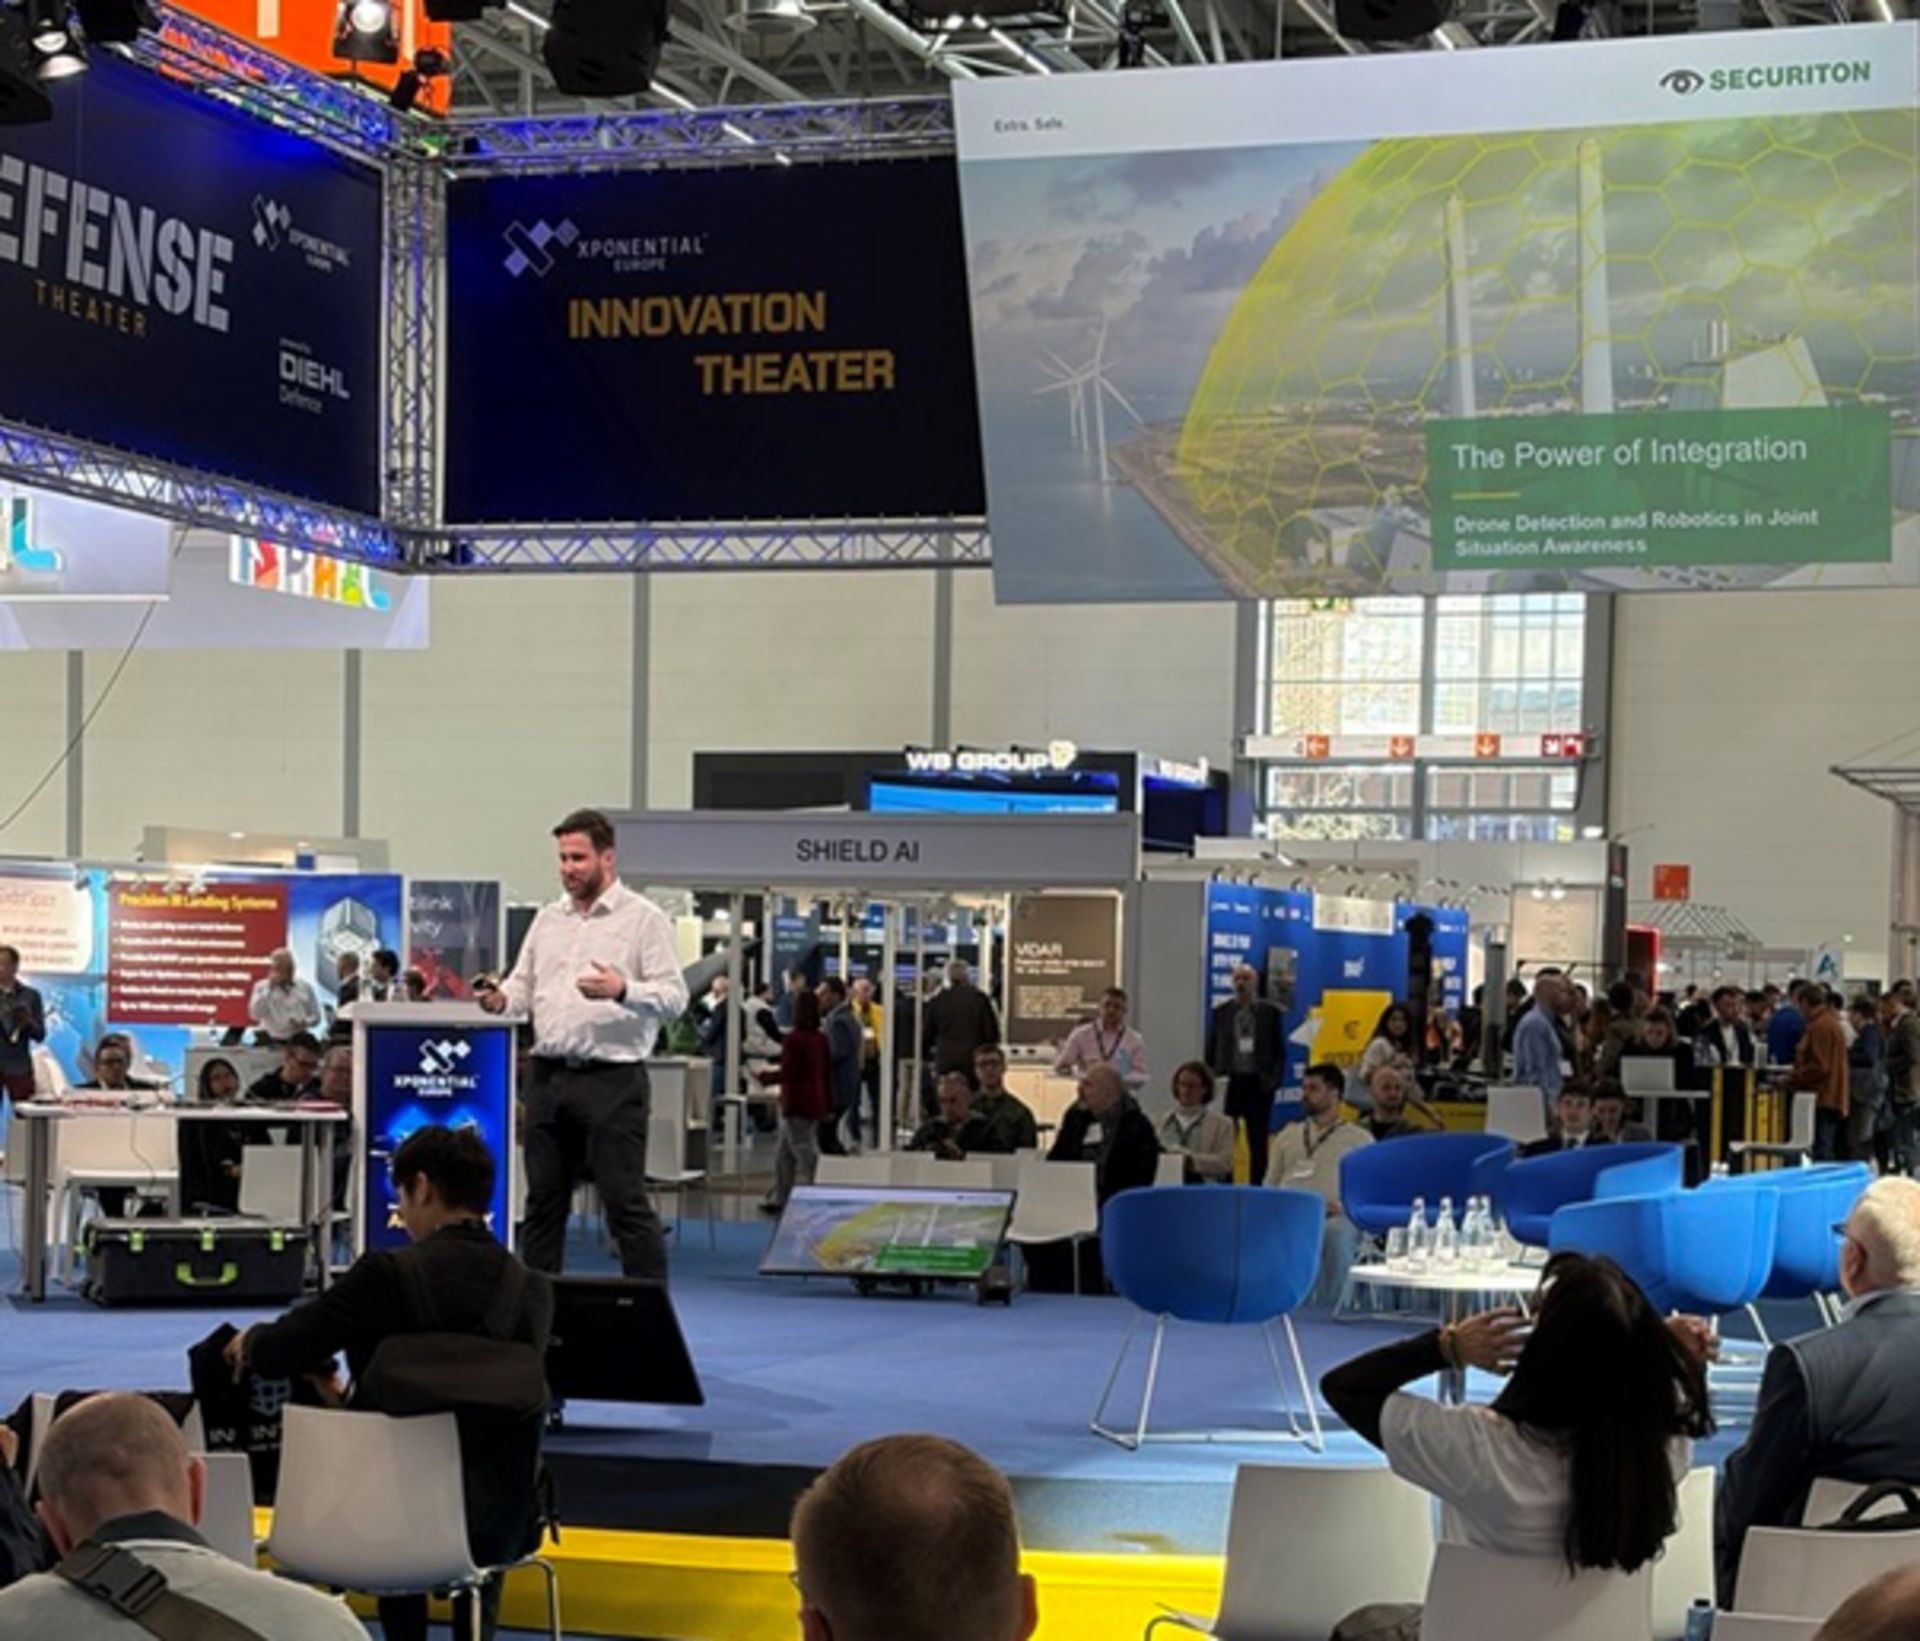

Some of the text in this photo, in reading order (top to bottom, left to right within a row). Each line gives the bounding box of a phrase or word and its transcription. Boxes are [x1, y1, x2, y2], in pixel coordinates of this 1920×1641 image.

[1709, 60, 1871, 91] SECURITON
[577, 237, 705, 258] XPONENTIAL
[613, 257, 667, 273] EUROPE
[34, 278, 148, 337] THEATER
[569, 292, 825, 338] INNOVATION
[279, 352, 351, 399] DIEHL
[695, 350, 895, 395] THEATER
[1451, 434, 1808, 470] The Power of Integration
[1455, 507, 1820, 534] Drone Detection and Robotics in Joint
[1455, 536, 1648, 558] Situation Awareness
[905, 751, 1049, 772] WB GROUP
[796, 838, 920, 862] SHIELD AI
